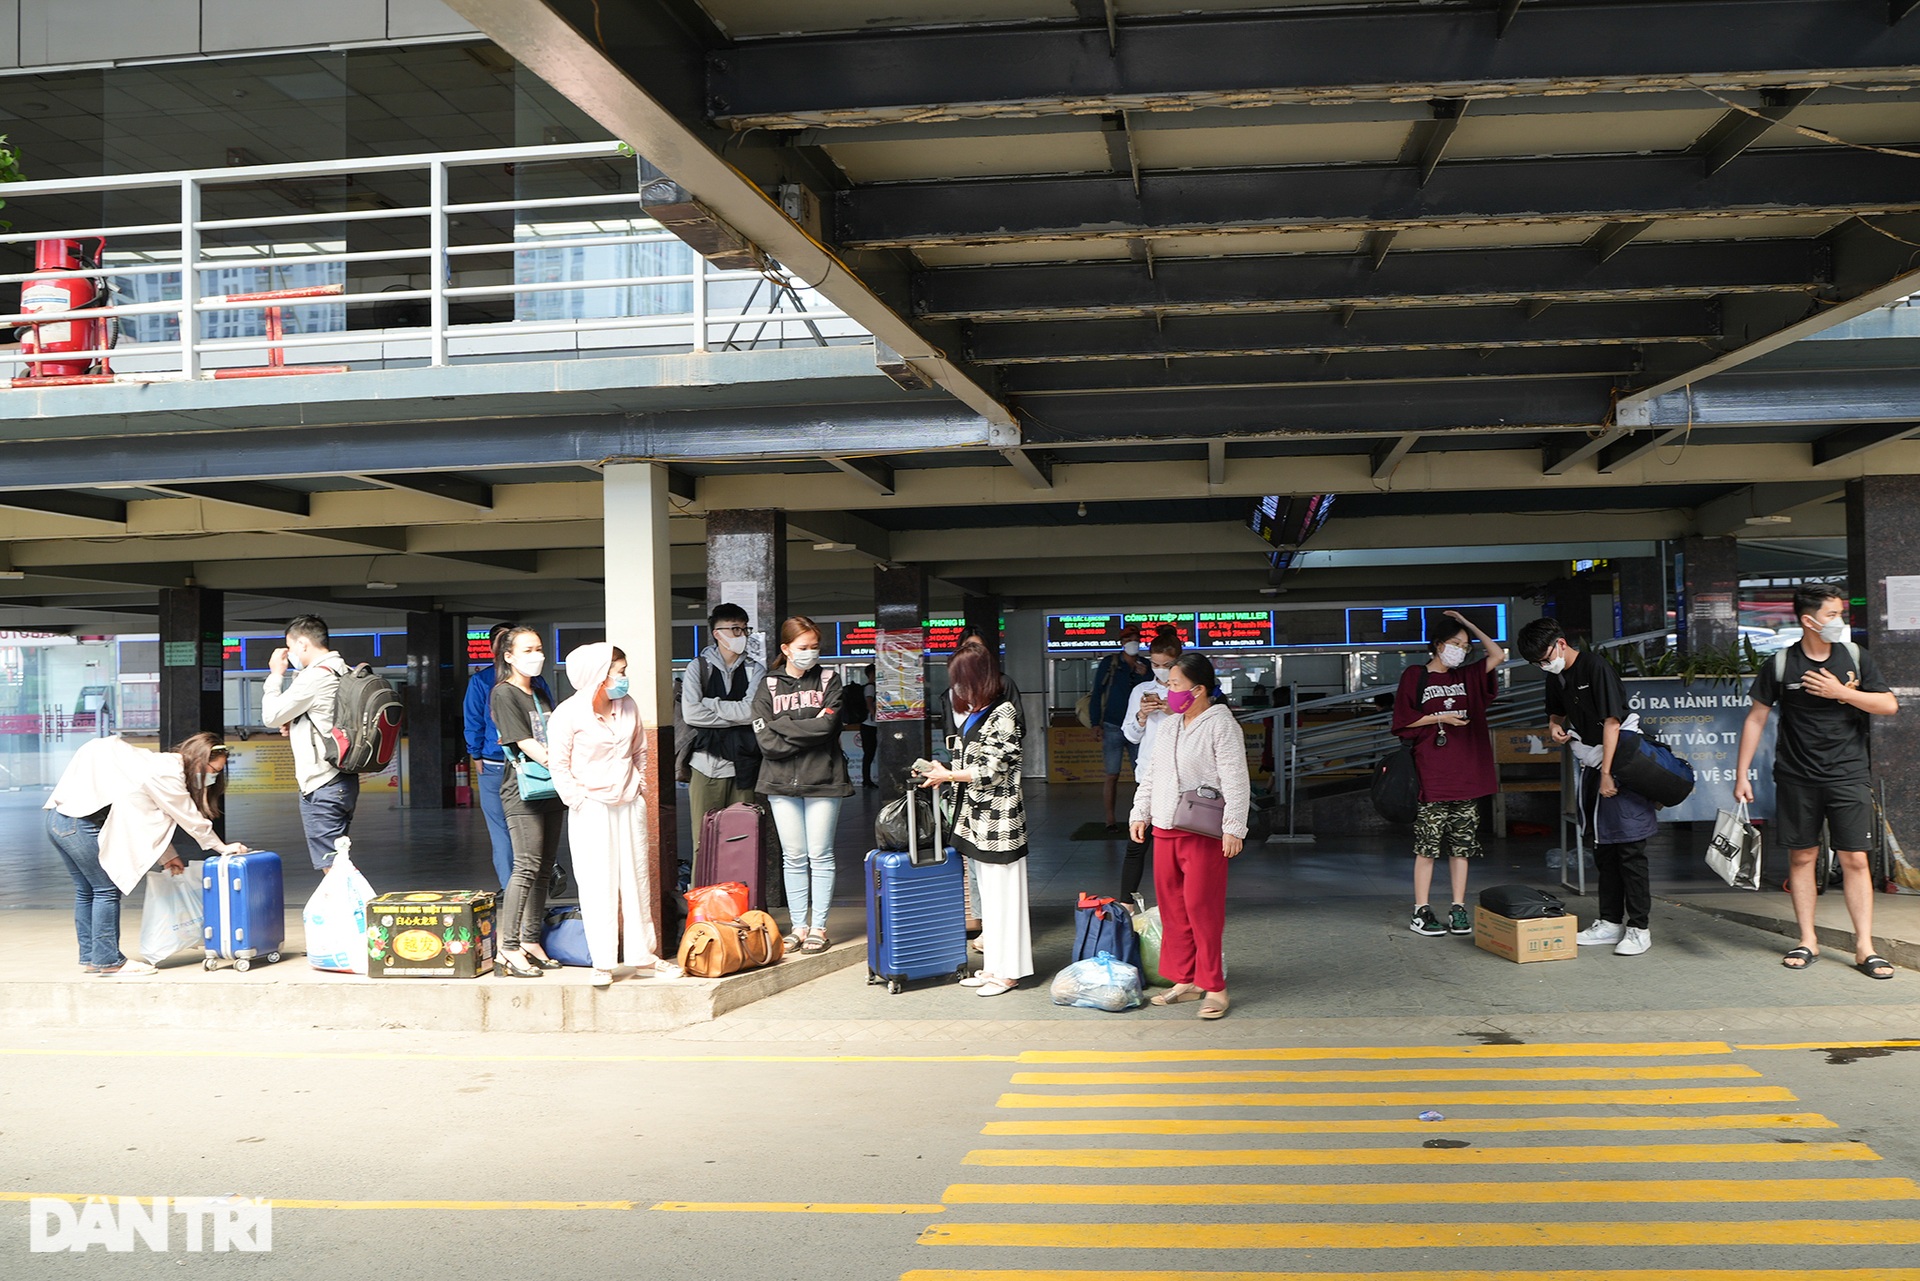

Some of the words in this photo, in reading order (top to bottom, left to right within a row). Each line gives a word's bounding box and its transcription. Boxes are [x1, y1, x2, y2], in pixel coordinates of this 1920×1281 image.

[1628, 691, 1646, 710] ỐI
[1650, 697, 1670, 709] RA
[1674, 692, 1718, 708] HÀNH
[1721, 694, 1753, 707] KHÁ
[1685, 729, 1718, 745] VÀO
[1721, 732, 1737, 744] TT
[1702, 767, 1720, 784] VỆ
[1724, 769, 1758, 781] SIH
